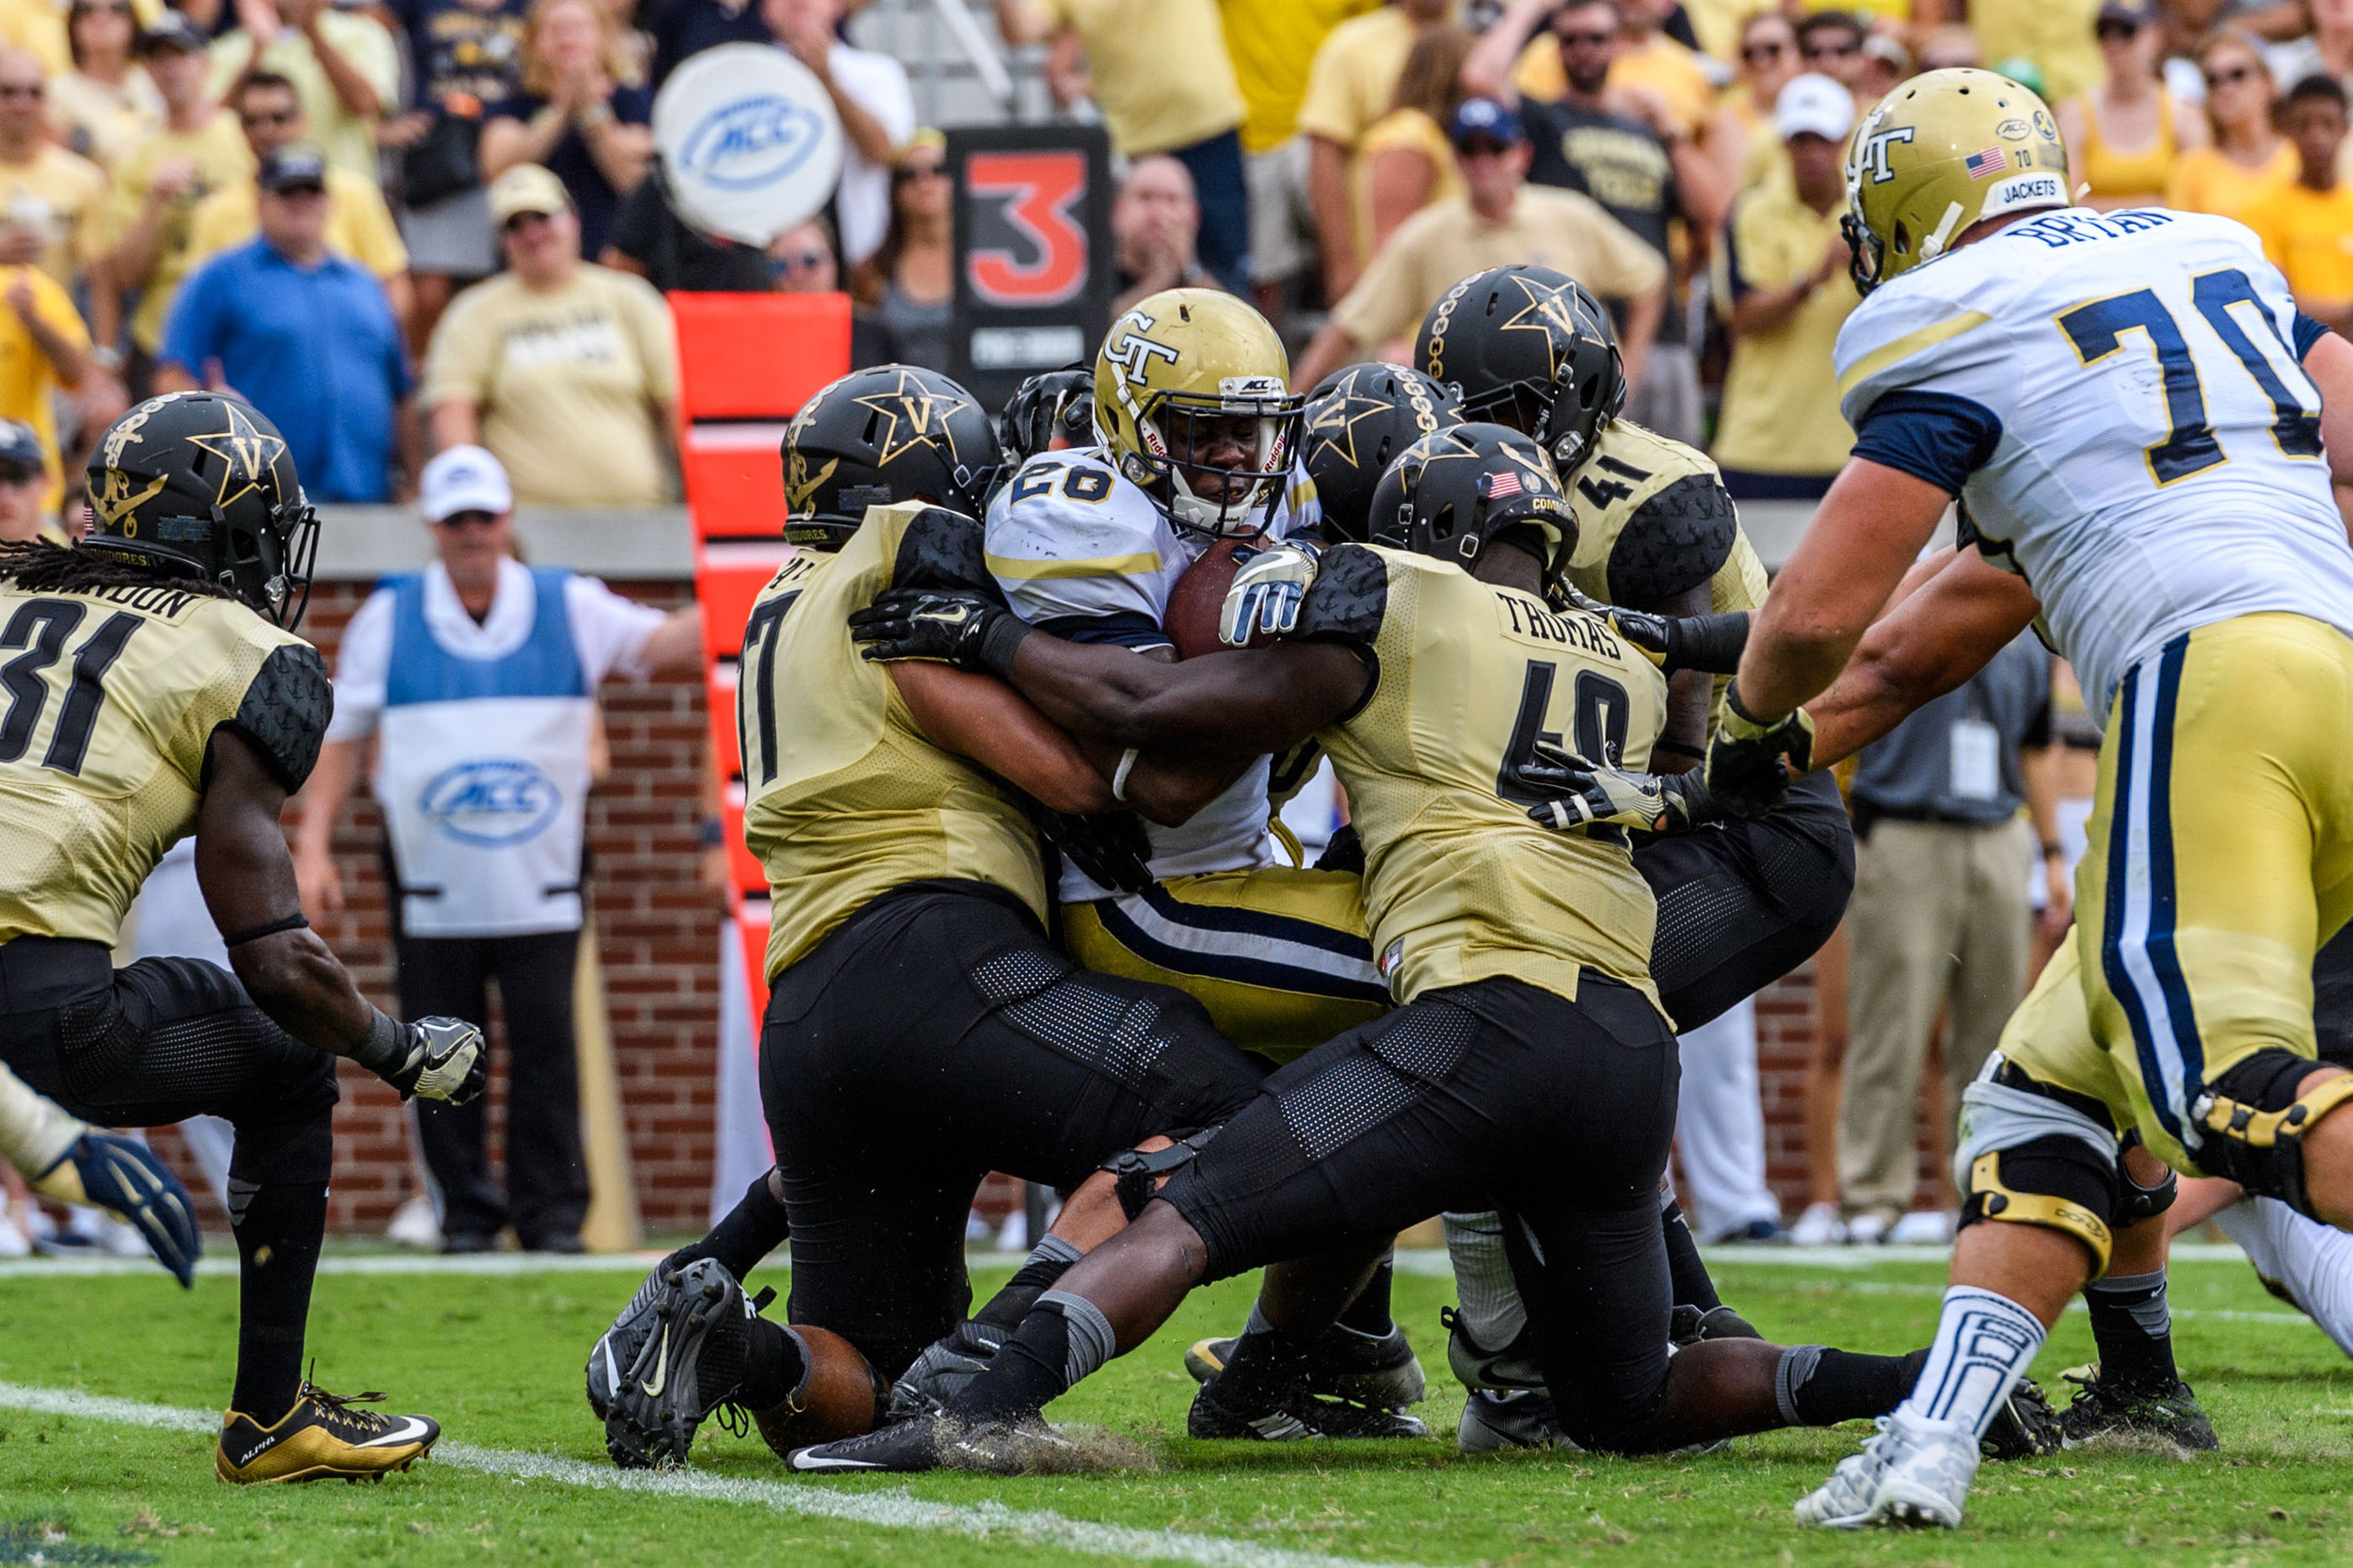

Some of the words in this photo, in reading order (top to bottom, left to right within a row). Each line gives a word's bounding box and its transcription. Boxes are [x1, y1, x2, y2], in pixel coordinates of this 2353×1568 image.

[2015, 149, 2032, 168] 70
[2004, 180, 2056, 203] JACKETS
[965, 150, 1090, 308] 3
[2005, 210, 2174, 248] BRYAN
[1536, 294, 1576, 336] V
[1102, 309, 1180, 388] GT
[1241, 379, 1270, 392] ACC
[2052, 266, 2327, 489] 70
[899, 396, 934, 435] V
[1311, 397, 1346, 430] V
[232, 437, 263, 480] V
[1577, 455, 1654, 510] 41
[1496, 592, 1622, 661] THOMAS
[0, 598, 147, 777] 31
[240, 1435, 276, 1464] ALPHA
